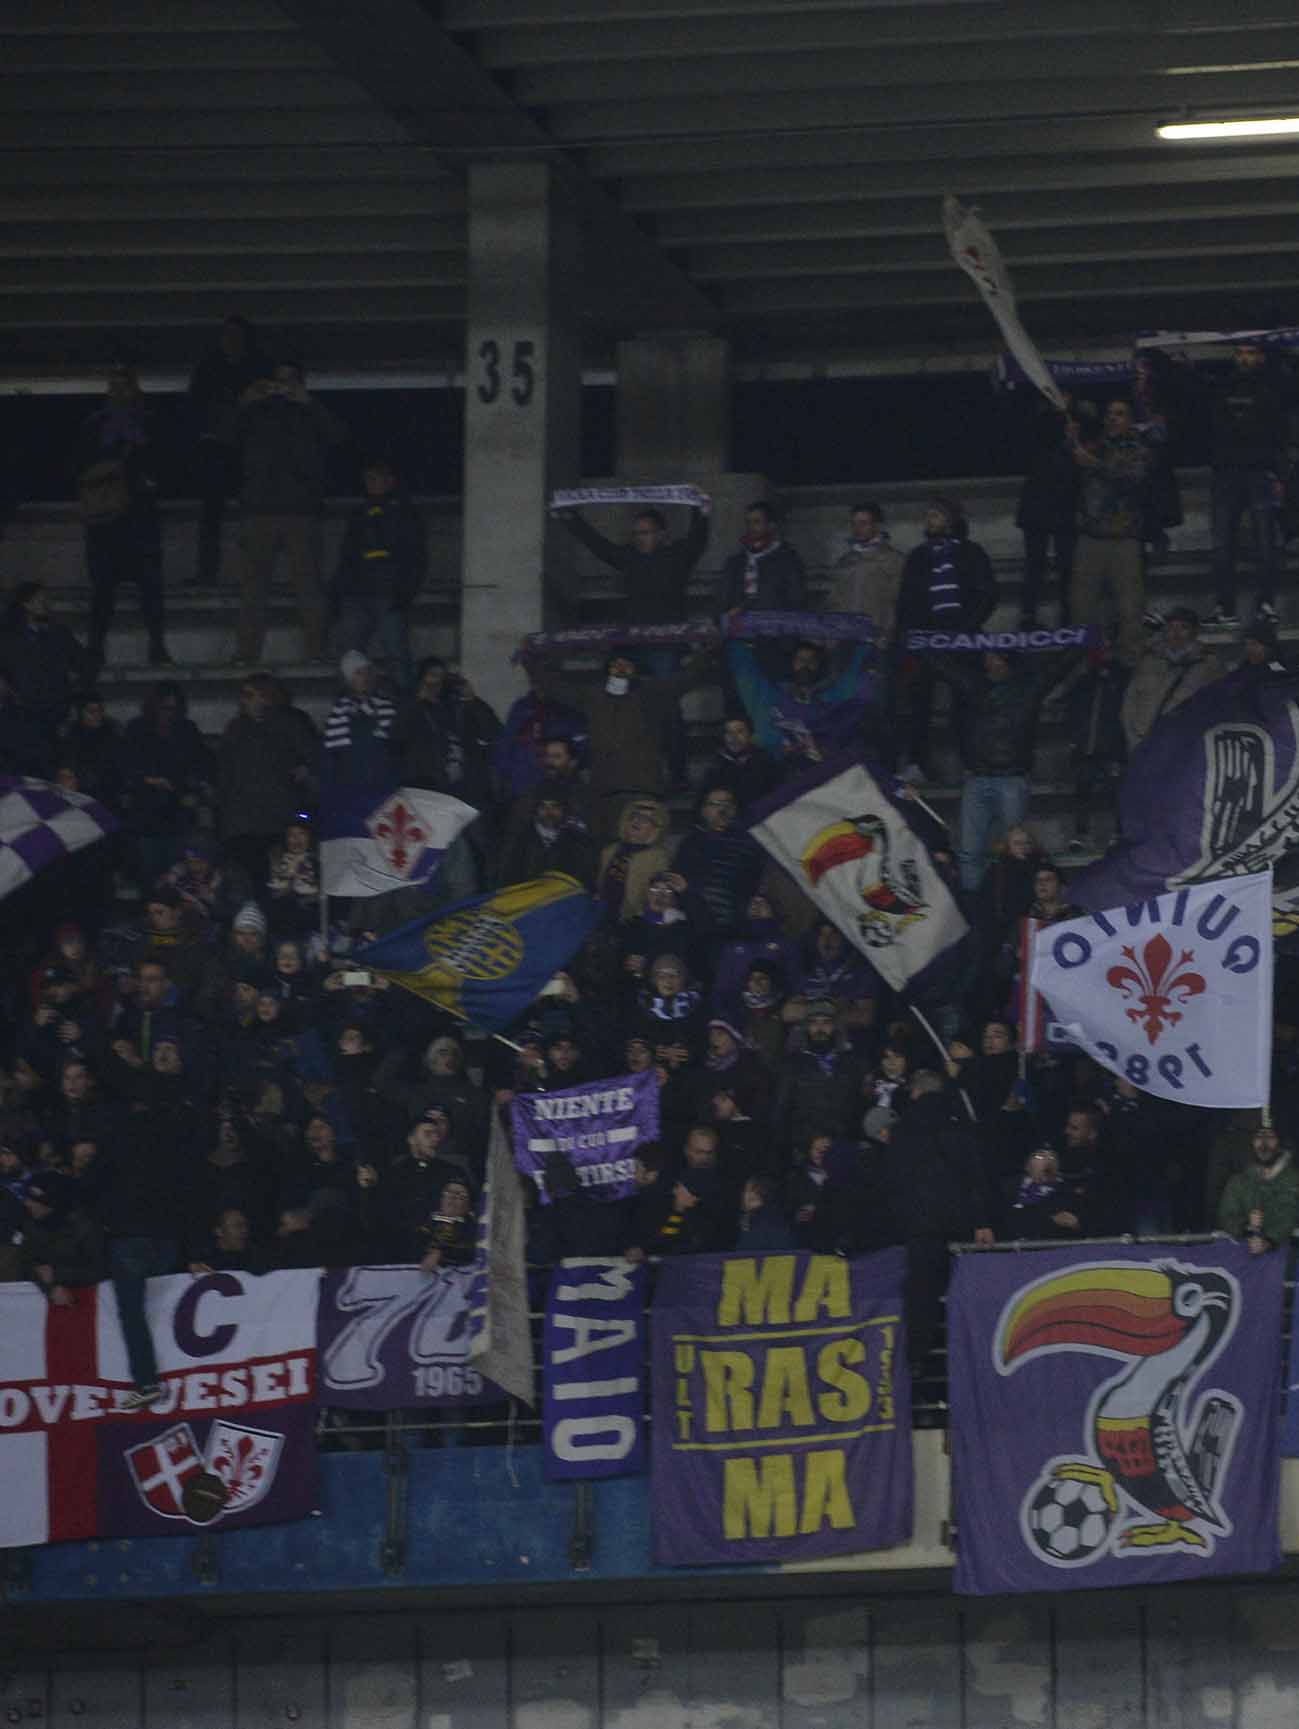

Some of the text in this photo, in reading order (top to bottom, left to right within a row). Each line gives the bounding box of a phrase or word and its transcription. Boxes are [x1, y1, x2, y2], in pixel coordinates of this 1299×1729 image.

[478, 340, 535, 406] 35
[907, 626, 1092, 650] SCANDICCI
[534, 1087, 635, 1121] NIENTE
[173, 1273, 244, 1358] C
[718, 1254, 852, 1327] MA
[411, 1364, 484, 1398] 1965
[552, 1255, 640, 1462] MAIO
[674, 1338, 872, 1441] ULT RAS
[723, 1449, 856, 1541] MA
